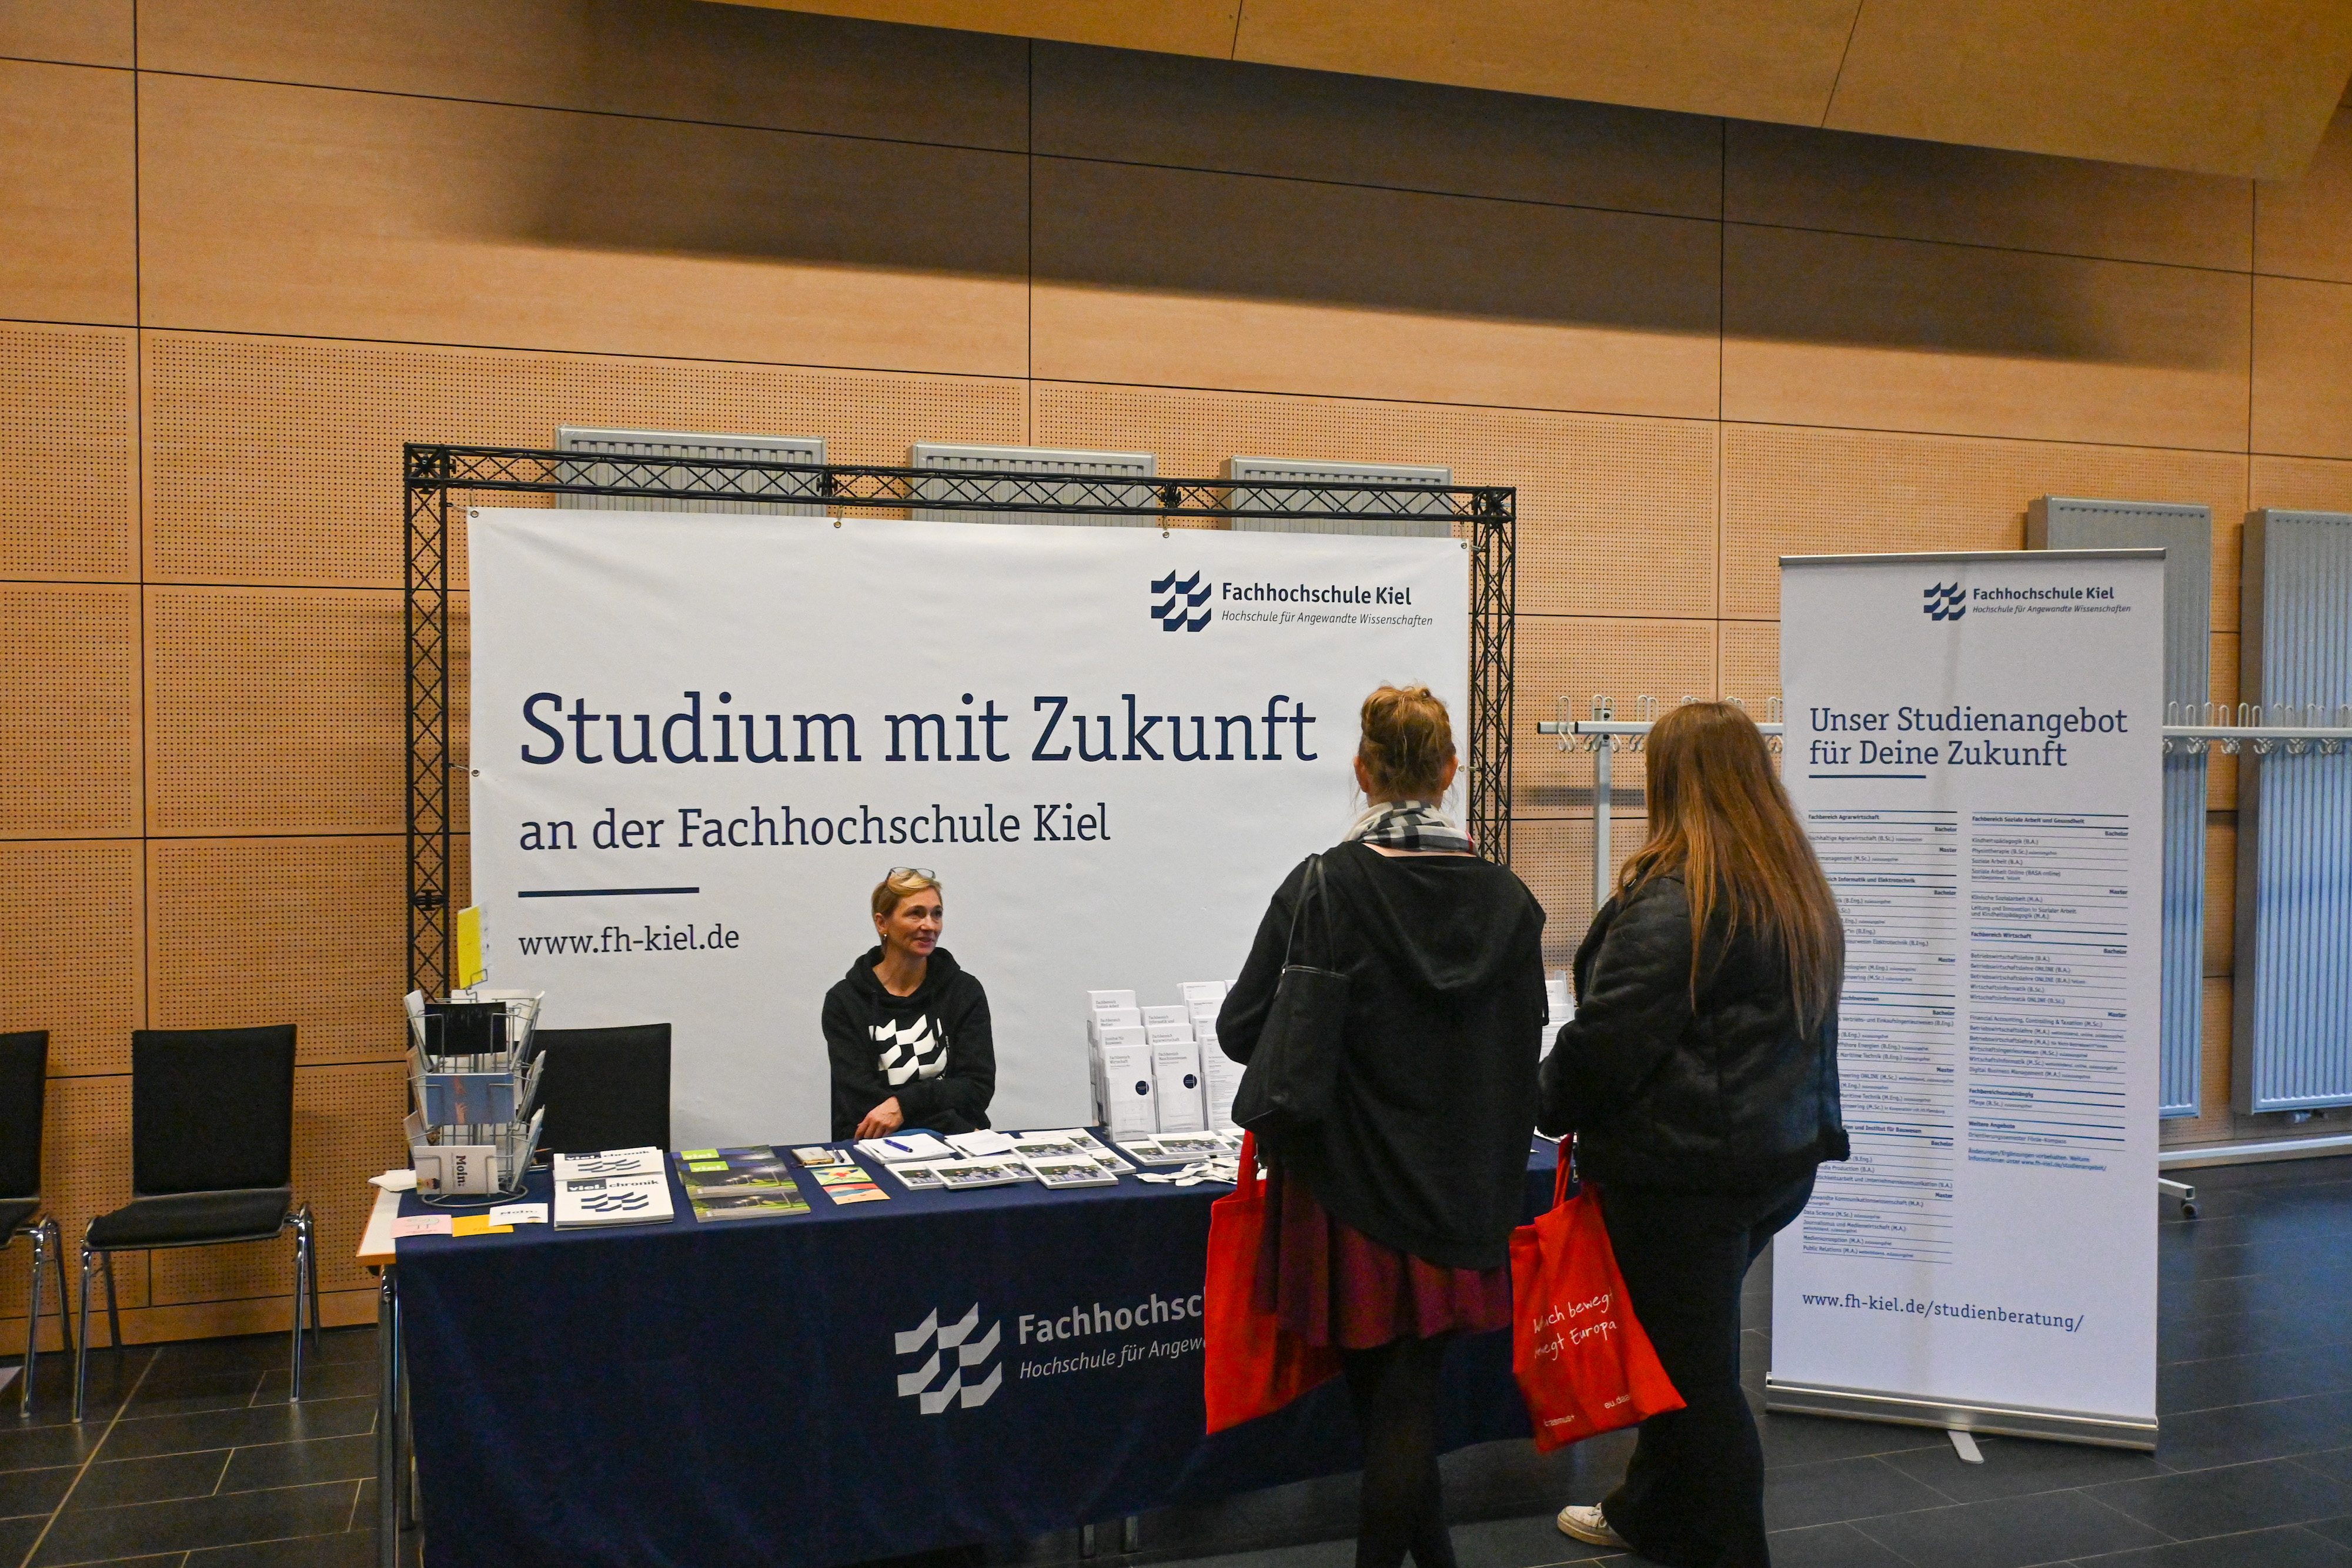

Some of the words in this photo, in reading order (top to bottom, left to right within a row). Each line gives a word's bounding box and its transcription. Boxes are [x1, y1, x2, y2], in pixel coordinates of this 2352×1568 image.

[1222, 582, 1371, 604] Fachhochschule
[1376, 586, 1412, 605] Kiel
[1973, 587, 2083, 600] Fachhochschule
[2086, 586, 2114, 599] Kiel
[1222, 610, 1278, 622] Hochschule
[1278, 611, 1296, 624] für
[1297, 612, 1357, 626] Angewandte
[1360, 613, 1433, 627] Wissenschaften
[1973, 605, 2013, 613] Hochschule
[2013, 605, 2026, 614] für
[2026, 605, 2073, 614] Angewandte
[2074, 604, 2131, 614] Wissenschaften
[521, 691, 862, 765] Studium
[884, 693, 1010, 762] mit
[1031, 694, 1318, 762] Zukunft
[1810, 707, 1890, 732] Unser
[1897, 706, 2129, 739] Studienangebot
[1809, 740, 1852, 765] für
[1859, 739, 1939, 765] Deine
[1947, 740, 2067, 767] Zukunft
[520, 821, 577, 851] an
[593, 807, 665, 850] der
[678, 803, 1020, 847] Fachhochschule
[1033, 802, 1111, 841] Kiel
[518, 923, 739, 955] www.fh-kiel.de
[609, 1179, 659, 1188] chronik
[1018, 1286, 1205, 1345] Fachhochsc
[1802, 1293, 2084, 1333] www.fh-kiel.de/studienberatung/
[1569, 1320, 1617, 1345] Europa
[1020, 1348, 1115, 1379] Hochschule
[1117, 1344, 1145, 1368] für
[1148, 1337, 1205, 1359] Angew
